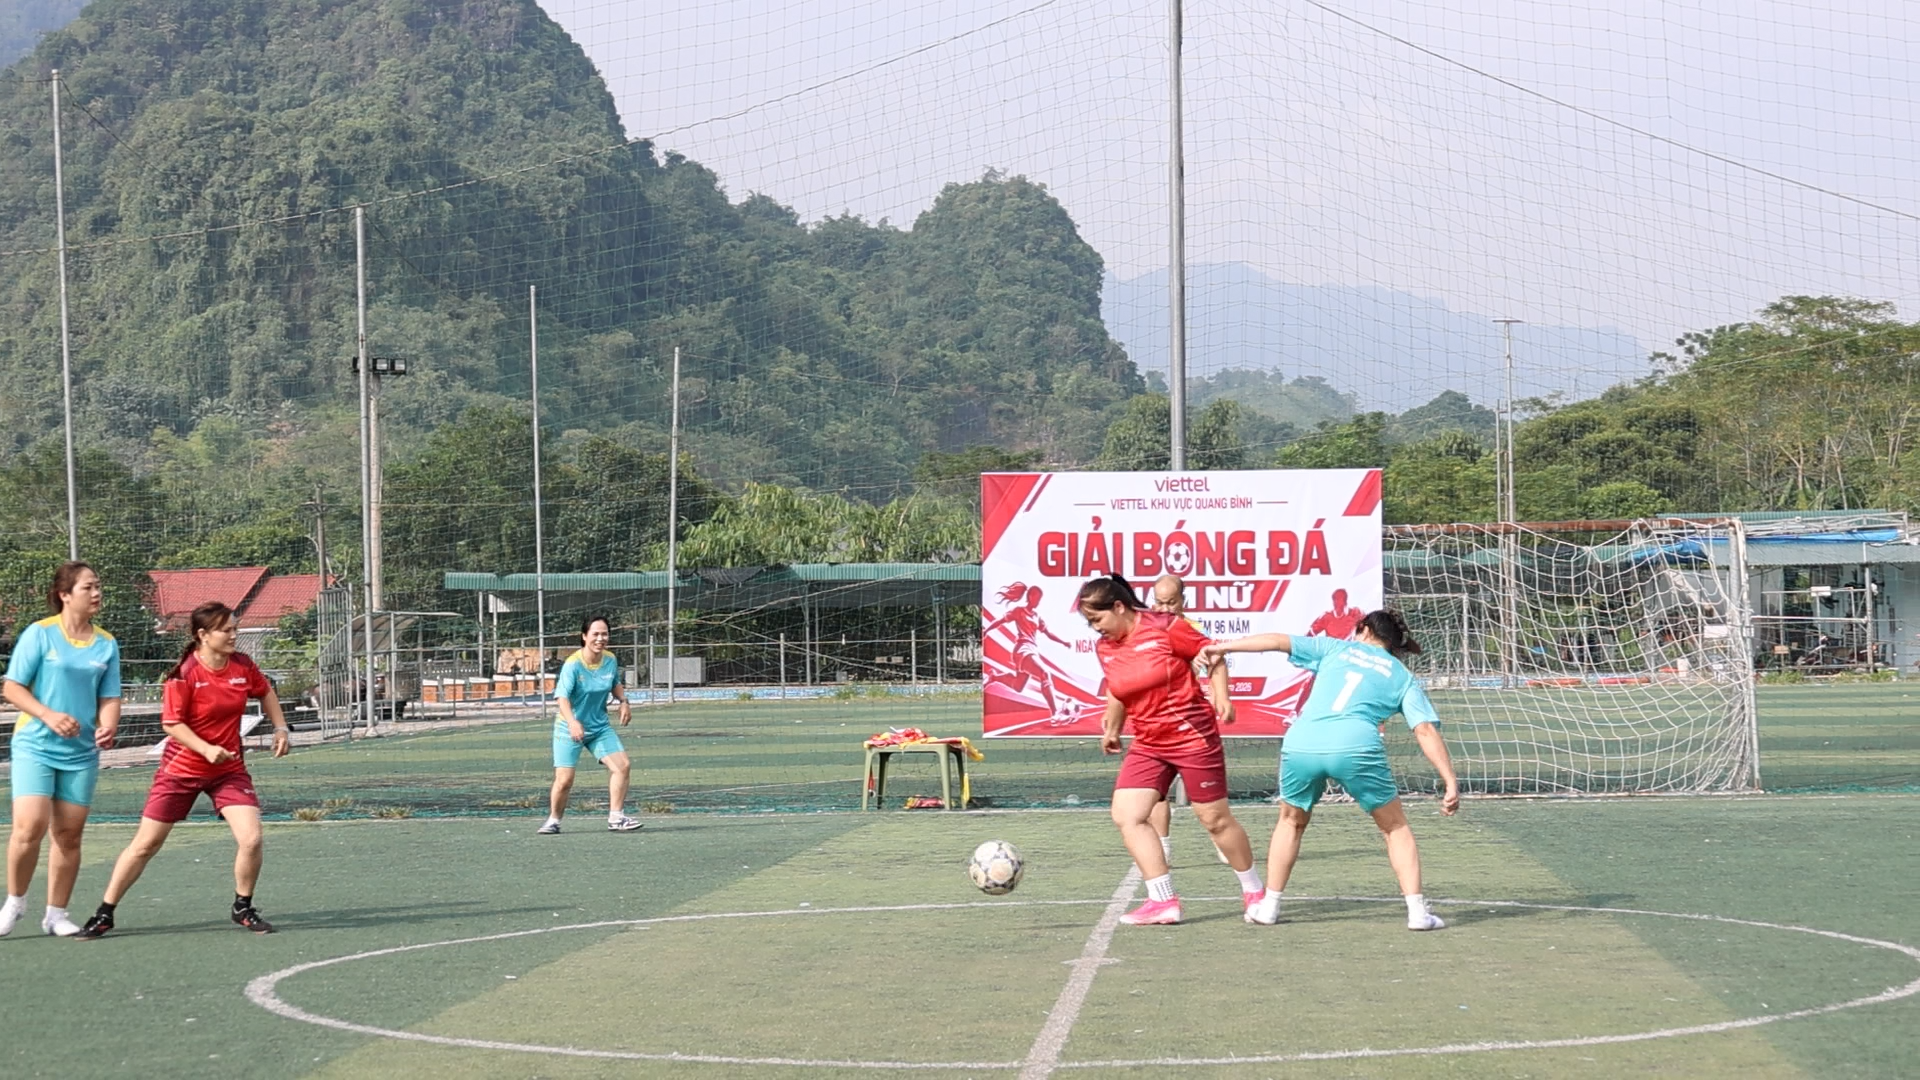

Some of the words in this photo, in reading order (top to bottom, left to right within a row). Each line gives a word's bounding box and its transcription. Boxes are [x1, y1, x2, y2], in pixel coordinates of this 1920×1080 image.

[1154, 476, 1211, 493] viettel
[1110, 498, 1148, 511] VIETTEL
[1151, 498, 1171, 510] KHU
[1173, 497, 1192, 512] VỰC
[1195, 497, 1228, 510] QUANG
[1230, 494, 1253, 509] BÌNH
[1037, 515, 1124, 577] GIẢI
[1133, 519, 1257, 577] BÓNG
[1266, 518, 1332, 576] ĐÁ
[1205, 581, 1255, 610] NỮ
[1214, 619, 1226, 634] 96
[1228, 617, 1250, 634] NĂM
[1331, 670, 1364, 712] 1
